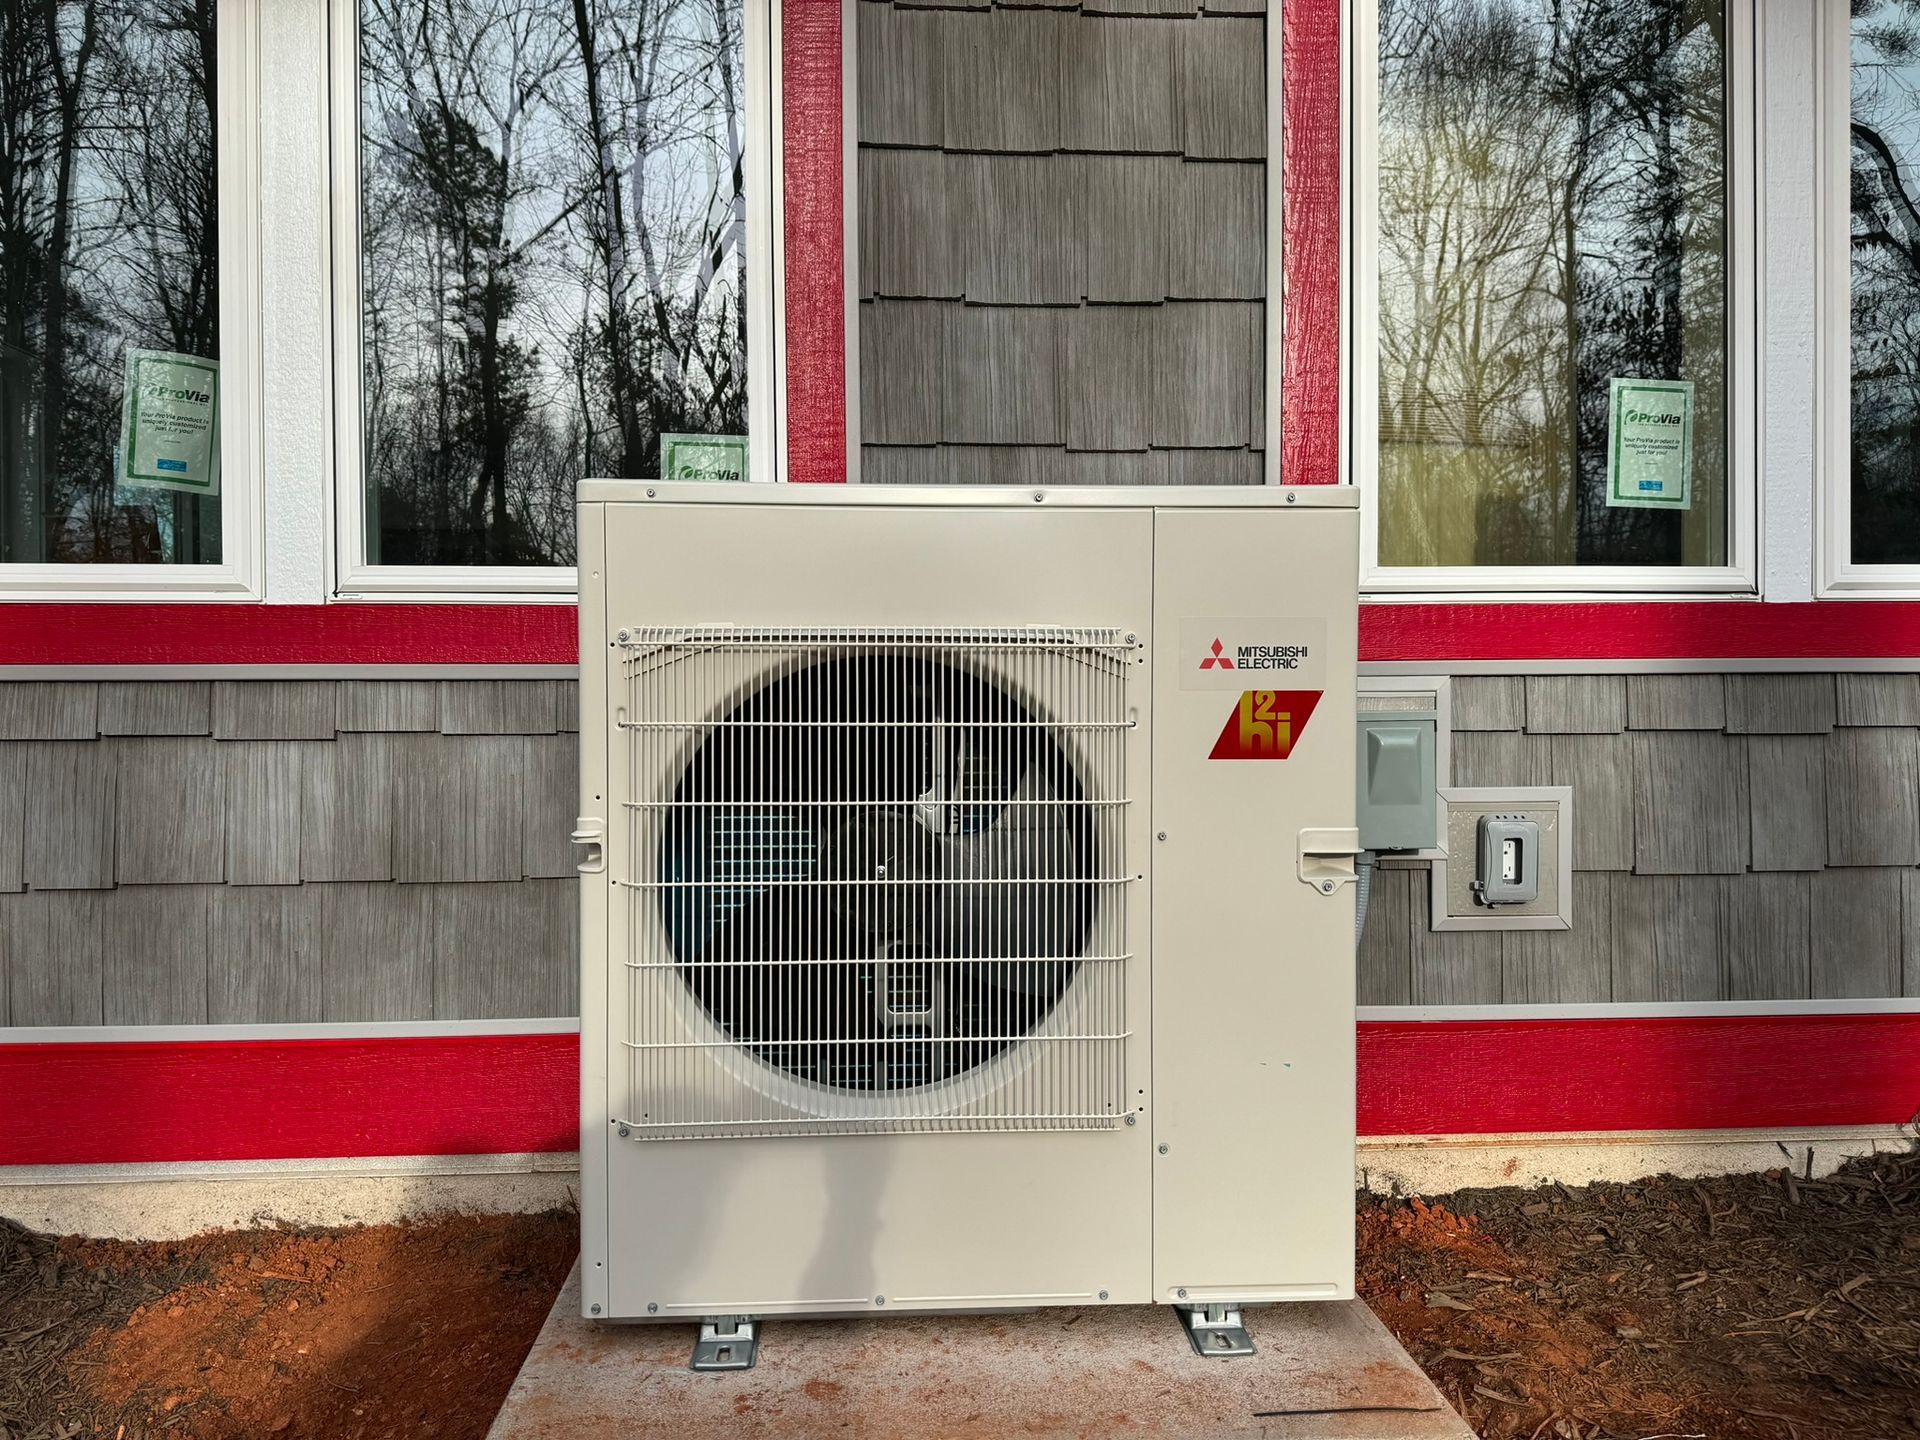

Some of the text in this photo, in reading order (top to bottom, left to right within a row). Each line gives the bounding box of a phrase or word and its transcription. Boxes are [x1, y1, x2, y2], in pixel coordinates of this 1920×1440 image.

[157, 386, 210, 404] ProVia
[155, 412, 175, 420] ProVia
[176, 415, 202, 424] product
[1638, 413, 1681, 424] ProVia
[169, 420, 207, 430] customized
[693, 469, 740, 481] ProVia
[1237, 646, 1308, 658] MITSUBISHI
[1237, 658, 1298, 669] ELECTRIC
